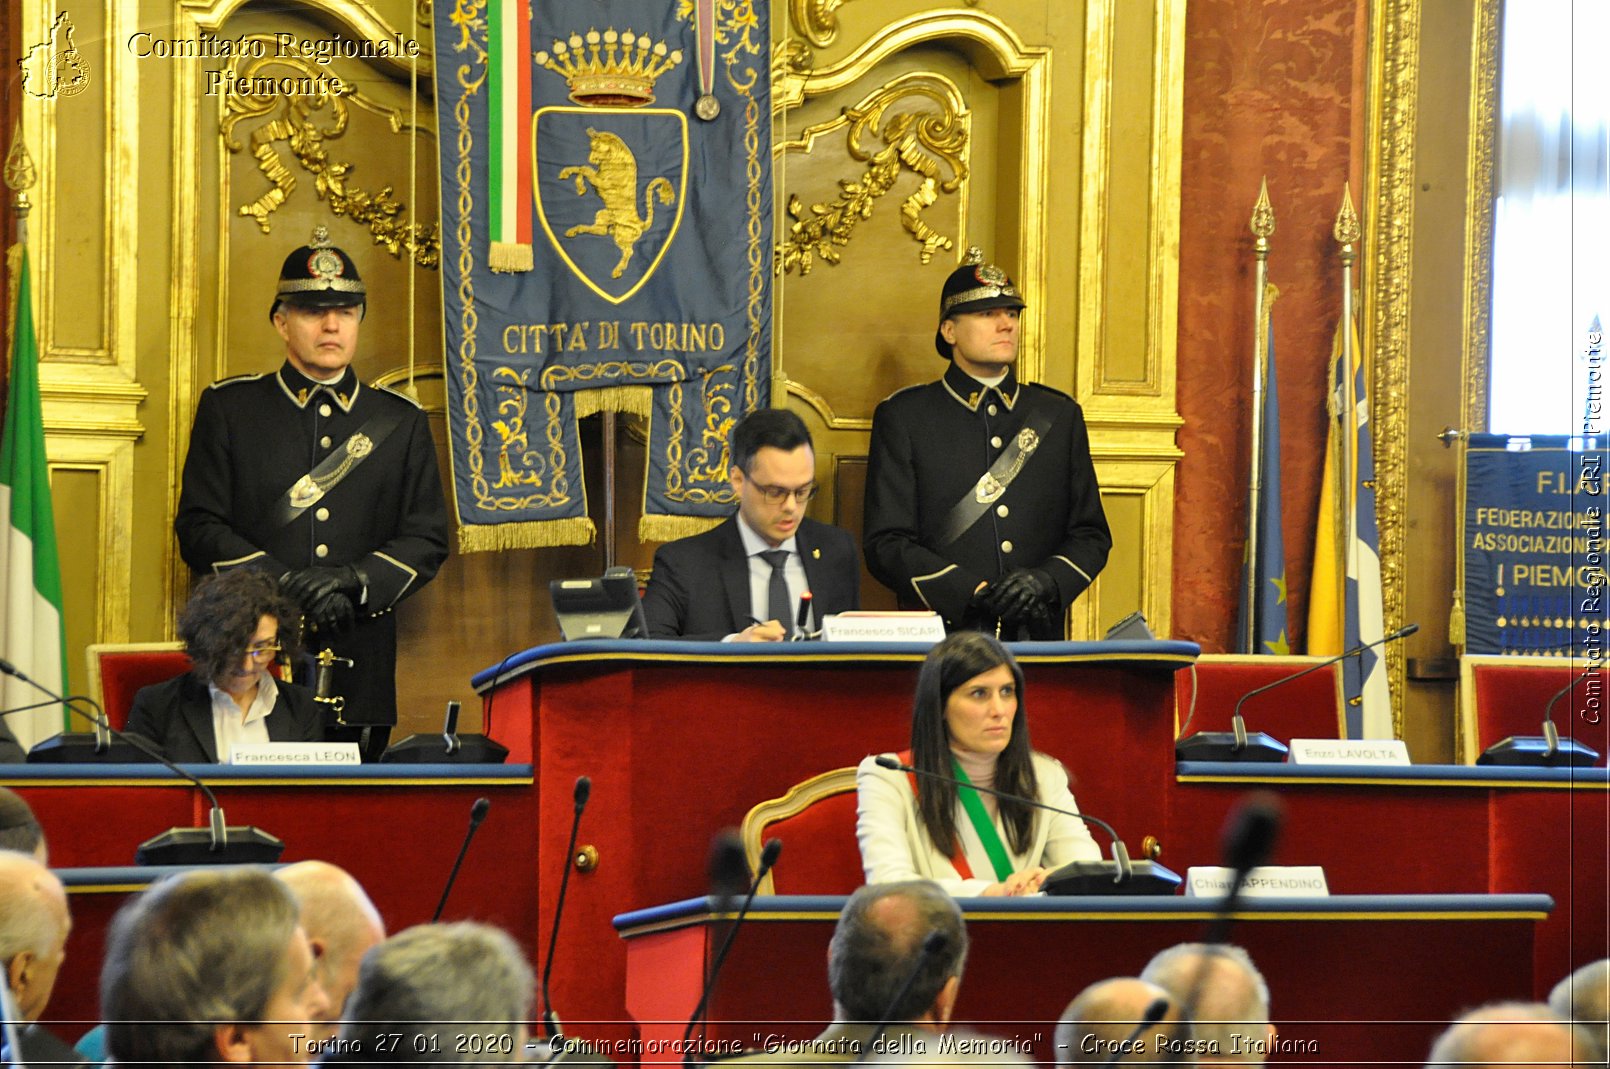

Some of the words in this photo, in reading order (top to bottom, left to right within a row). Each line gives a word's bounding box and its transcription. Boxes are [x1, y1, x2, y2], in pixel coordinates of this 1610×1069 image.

[502, 321, 590, 354] CITTA'
[598, 320, 620, 350] DI
[631, 322, 725, 352] TORINO
[1513, 564, 1610, 588] PIEMO
[830, 626, 894, 637] Francesco
[897, 626, 940, 637] SICARI
[235, 751, 310, 762] Francesca
[315, 751, 356, 762] LEON
[1305, 748, 1334, 758] Enzo
[1337, 749, 1397, 760] LAVOLTA
[1195, 879, 1240, 889] Chiar
[1241, 878, 1323, 889] APPENDINO
